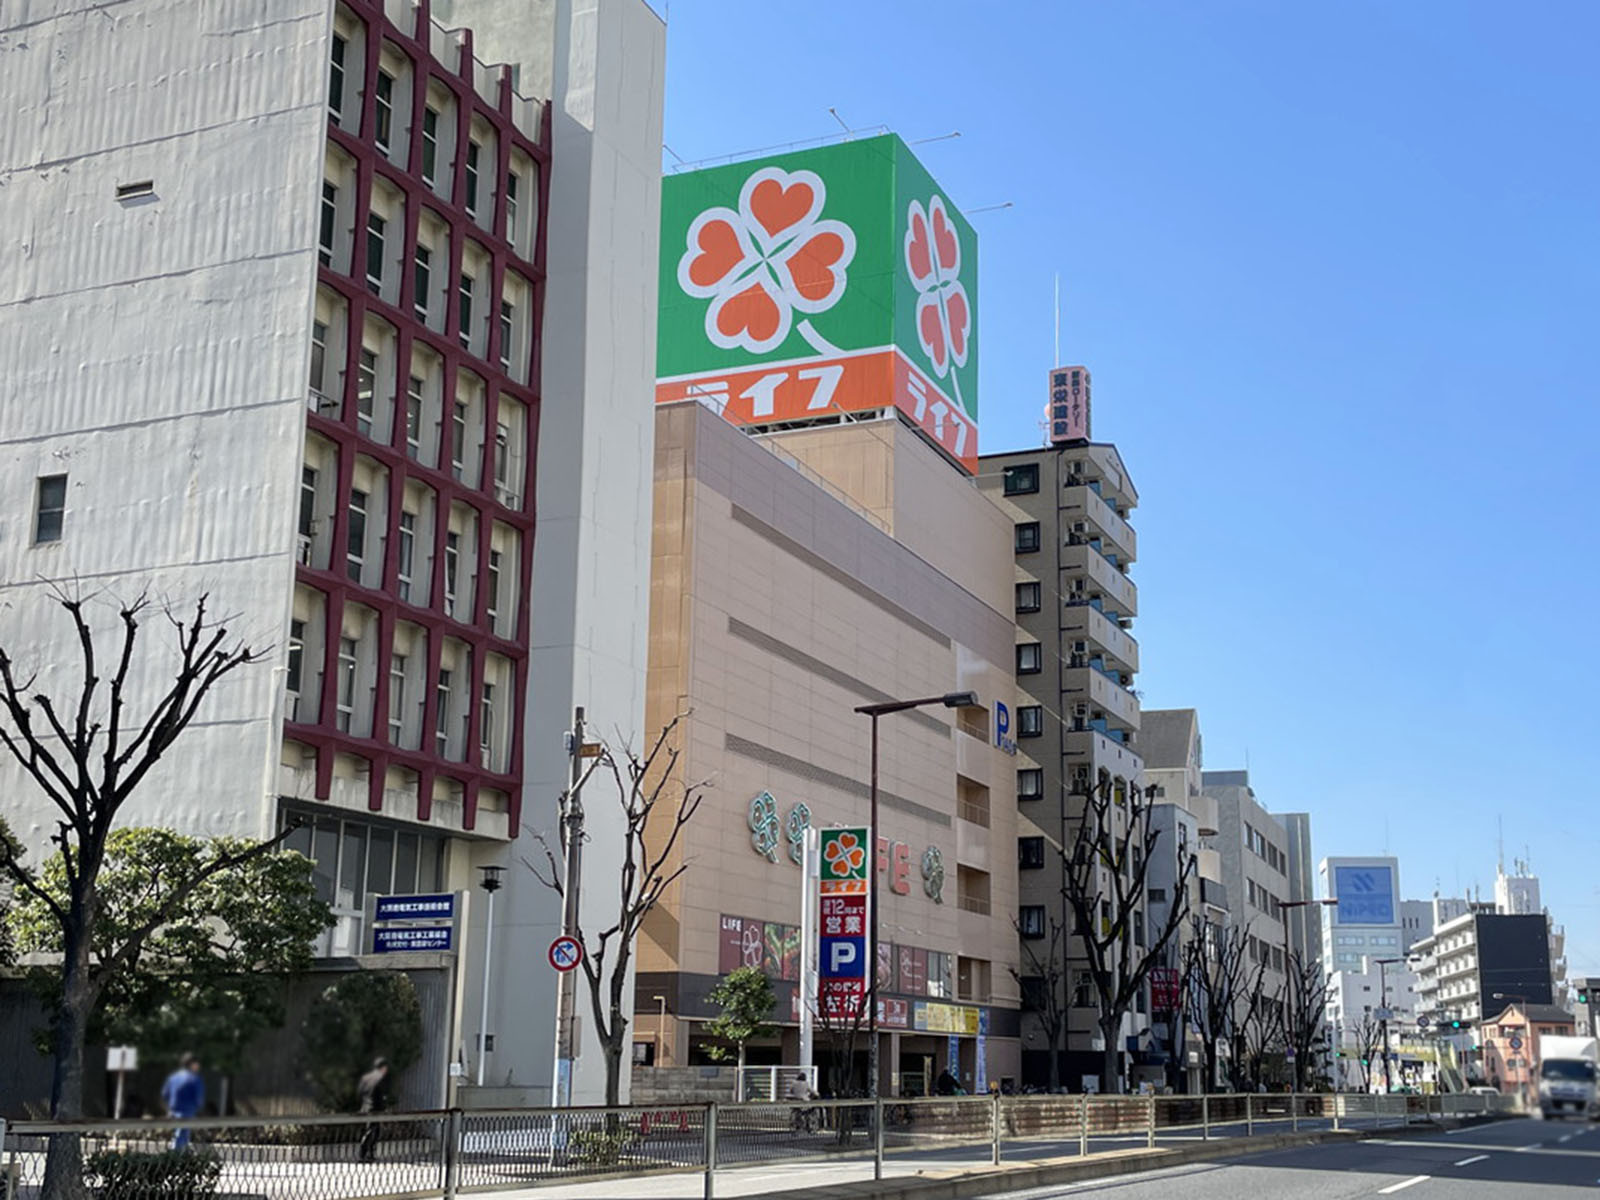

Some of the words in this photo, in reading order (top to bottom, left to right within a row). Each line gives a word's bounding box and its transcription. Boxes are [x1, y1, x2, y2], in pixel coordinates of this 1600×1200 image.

[685, 364, 845, 418] ライフ
[907, 371, 967, 457] ライフ
[995, 702, 1009, 747] P
[825, 881, 864, 892] ライフ
[722, 916, 742, 932] LIFE
[825, 915, 862, 934] 営業
[831, 942, 856, 972] P
